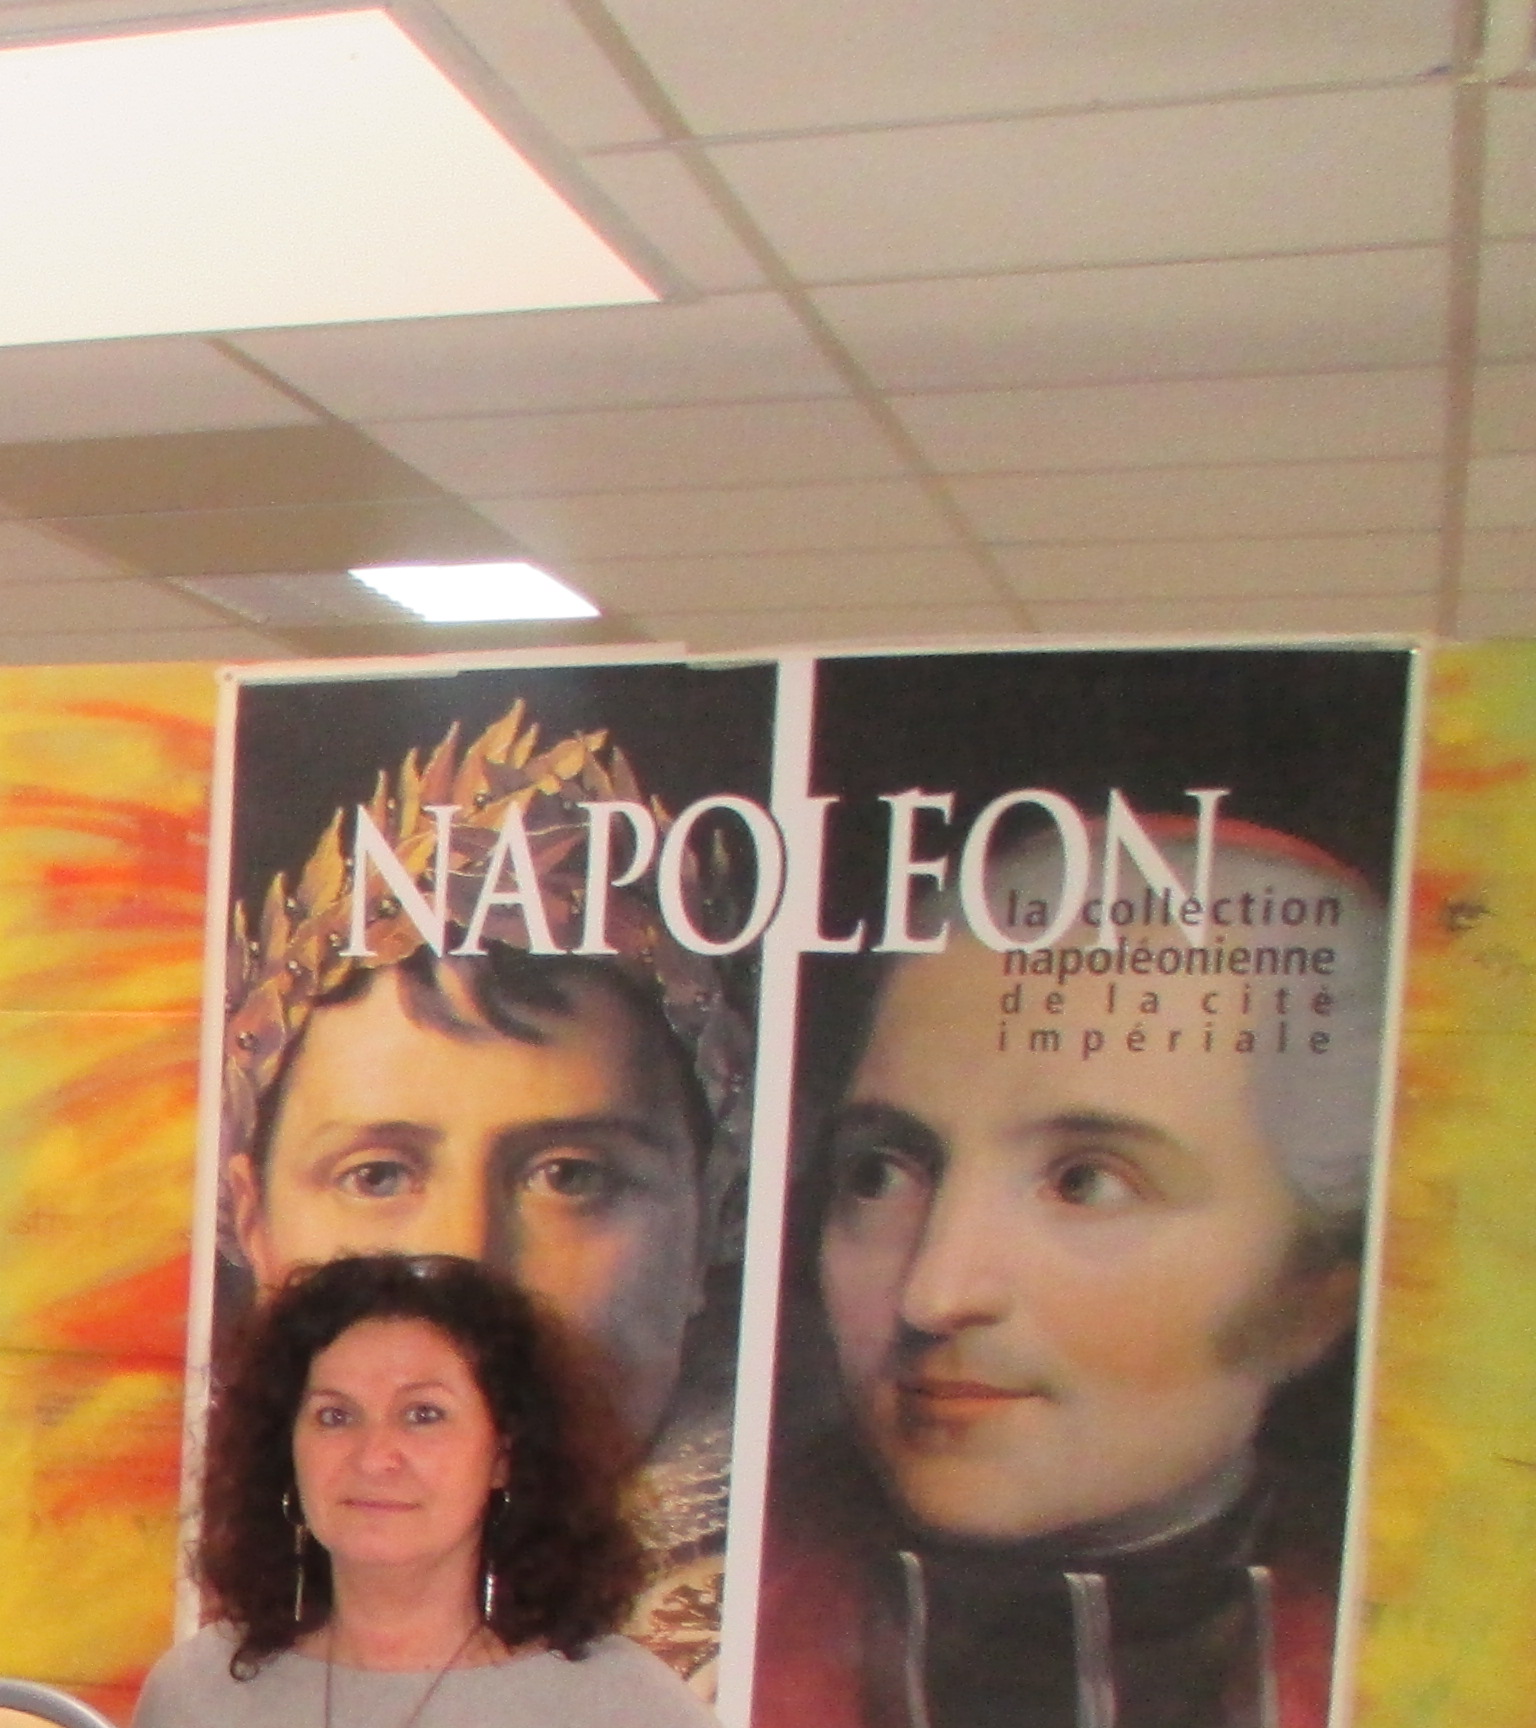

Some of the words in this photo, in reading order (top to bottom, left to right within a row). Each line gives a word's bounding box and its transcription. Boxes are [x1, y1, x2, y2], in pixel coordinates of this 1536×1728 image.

[1006, 889, 1049, 927] la
[1083, 884, 1342, 927] collection
[1003, 936, 1335, 985] napoléonienne
[998, 1022, 1331, 1060] impériale
